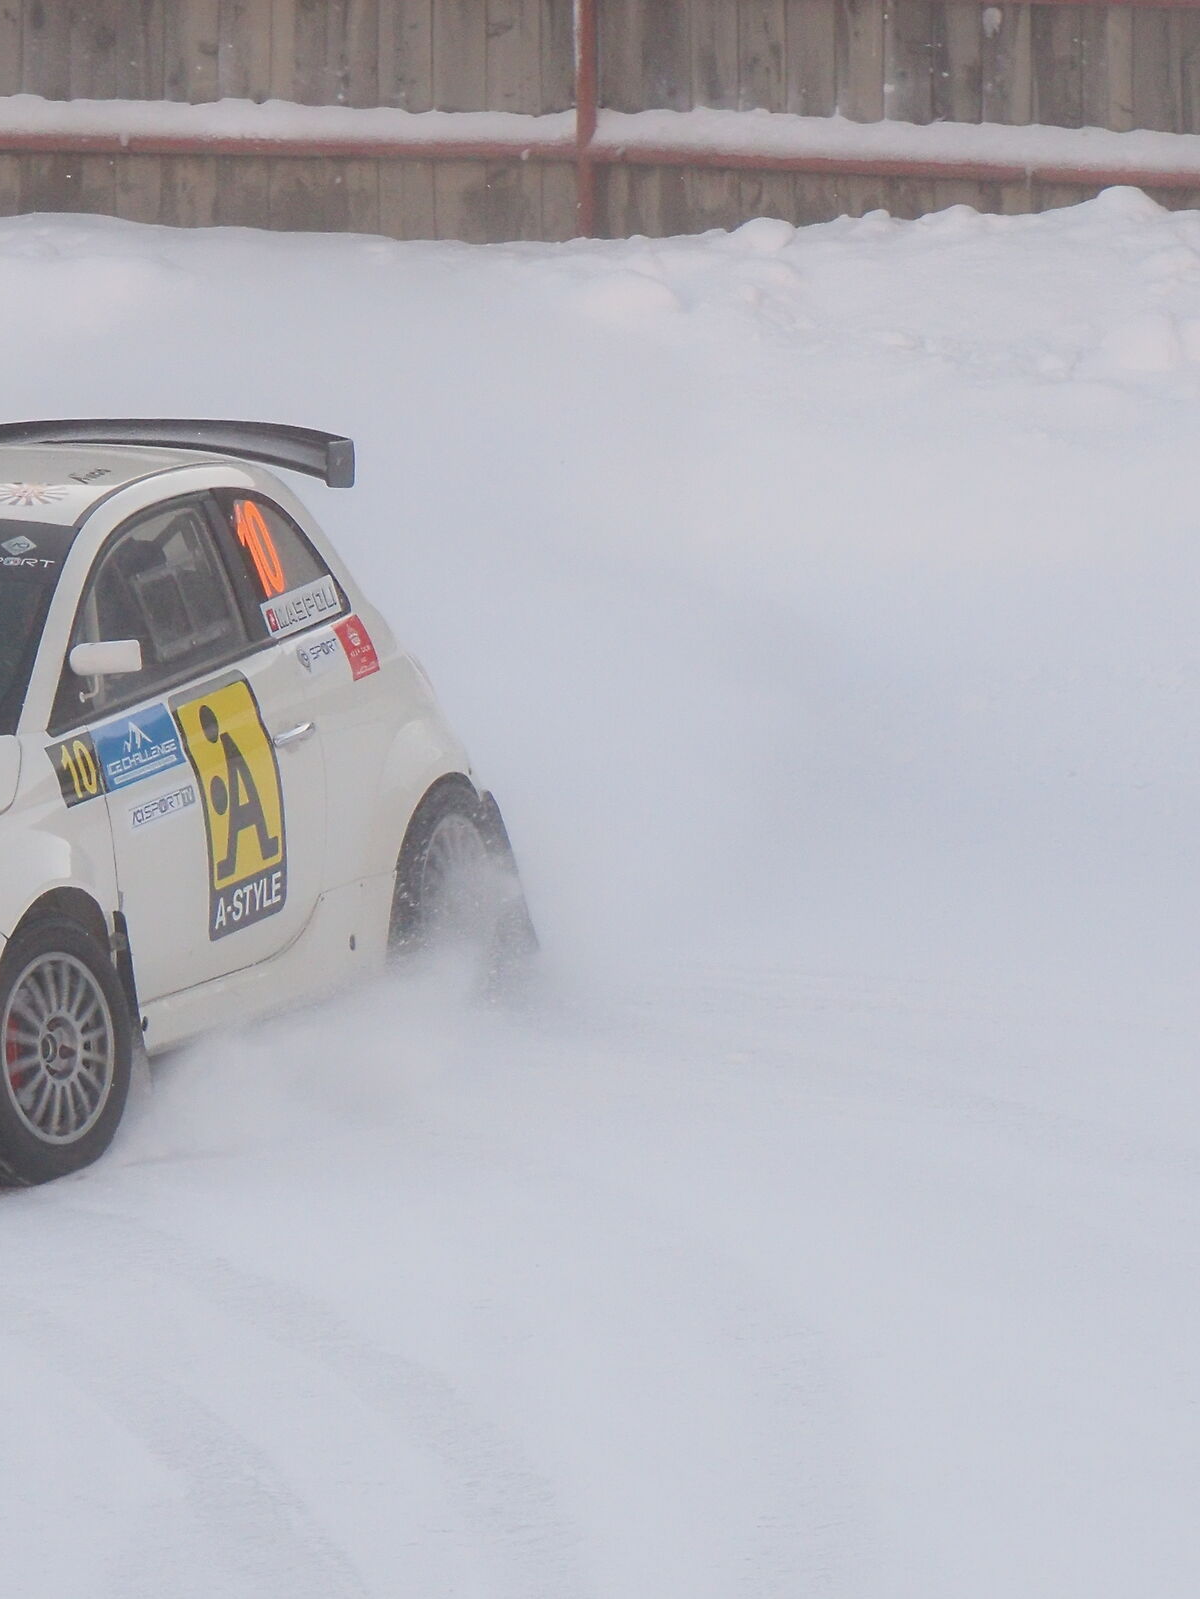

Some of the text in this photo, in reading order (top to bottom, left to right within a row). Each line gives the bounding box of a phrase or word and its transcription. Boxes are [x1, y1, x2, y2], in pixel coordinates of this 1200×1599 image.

[234, 498, 285, 598] 10
[274, 584, 338, 629] MASPOLI
[309, 637, 338, 661] SPORT
[60, 738, 100, 799] 10
[214, 870, 283, 931] A-STYLE
